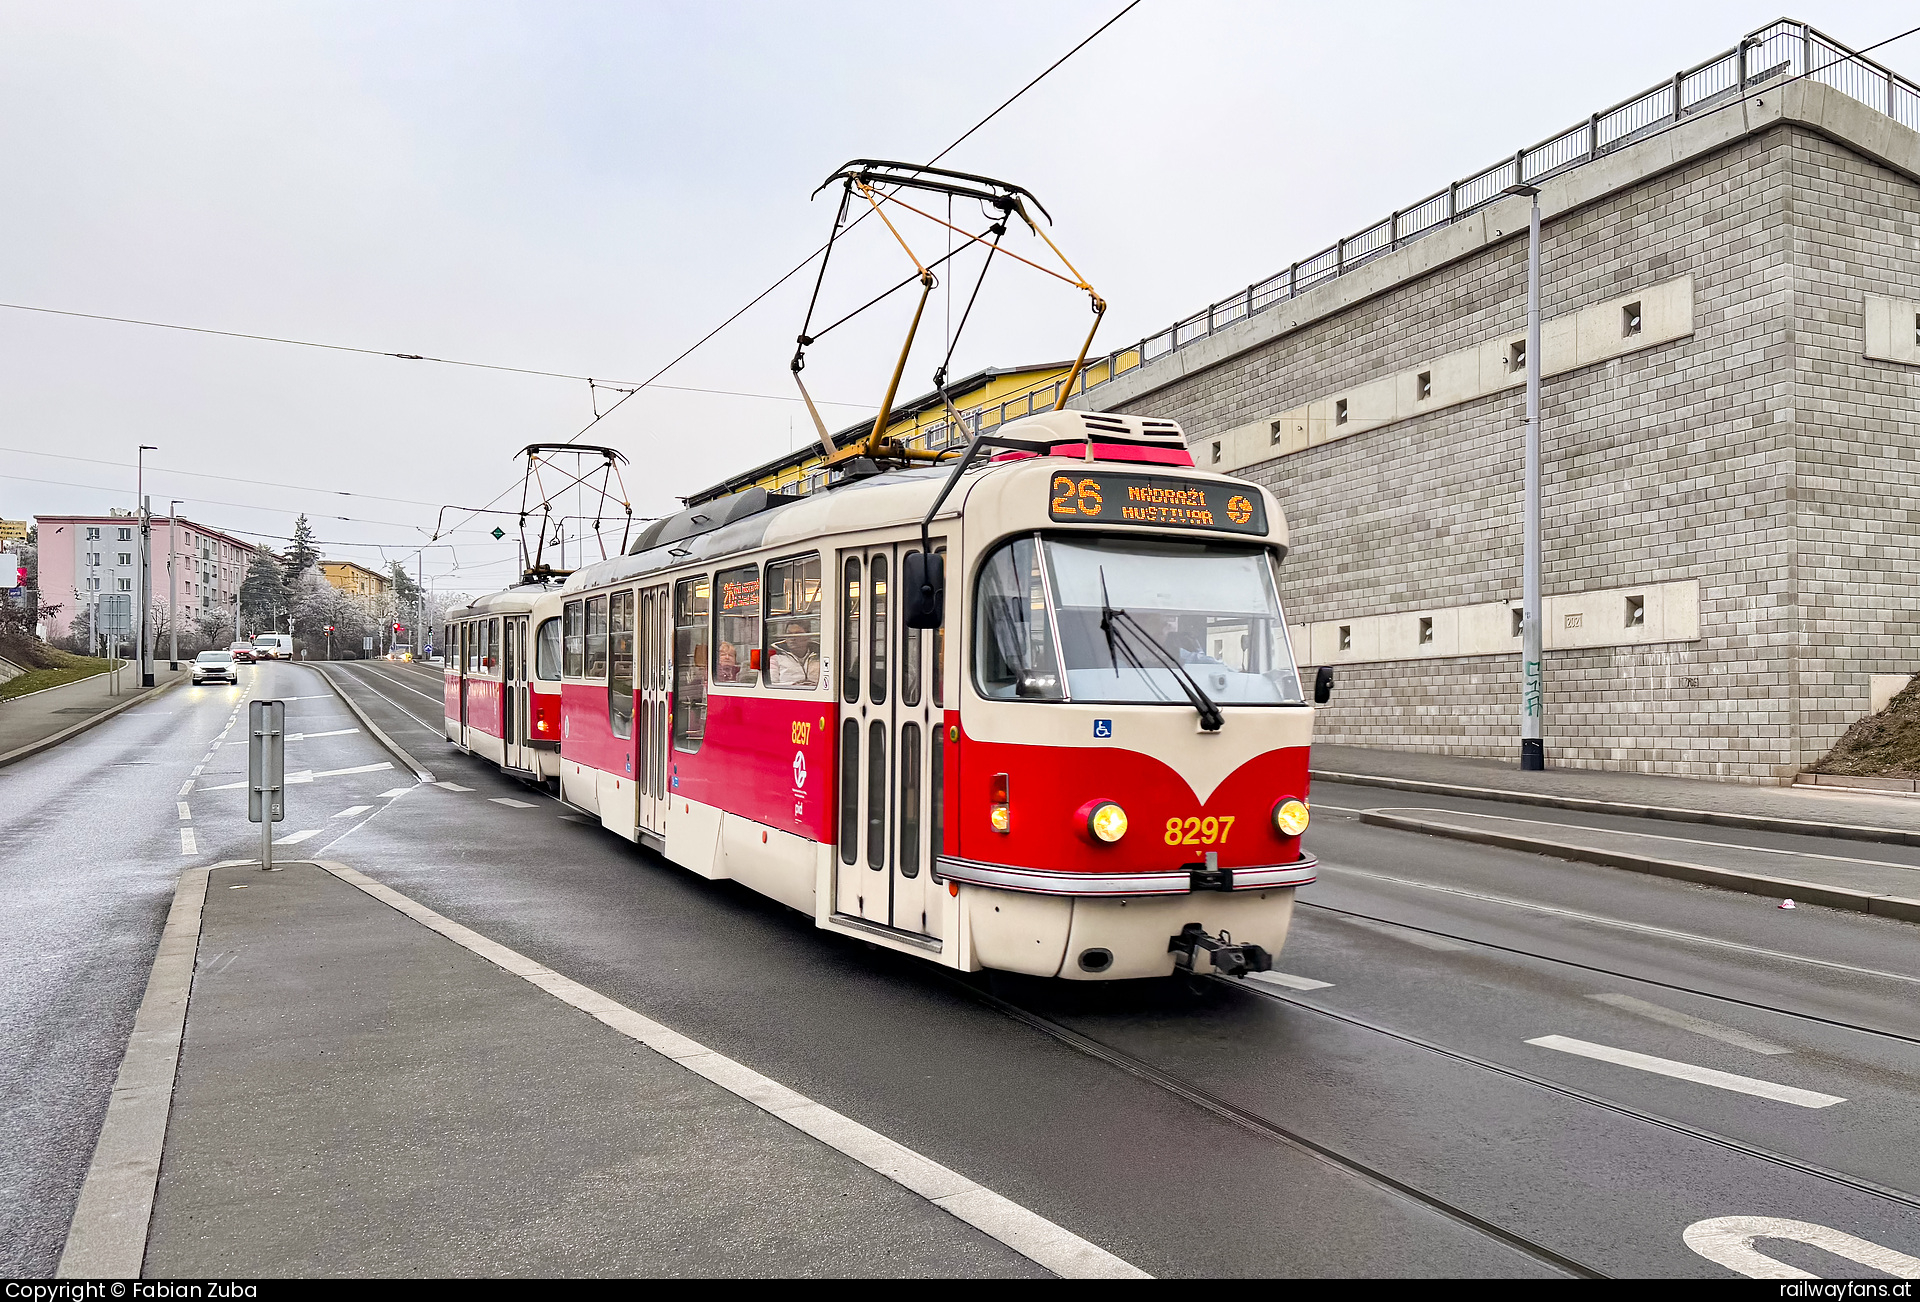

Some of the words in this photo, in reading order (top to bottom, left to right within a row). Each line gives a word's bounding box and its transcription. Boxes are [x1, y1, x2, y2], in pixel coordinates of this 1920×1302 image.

[1052, 477, 1103, 516] 26
[791, 720, 811, 746] 8297
[1164, 816, 1236, 846] 8297
